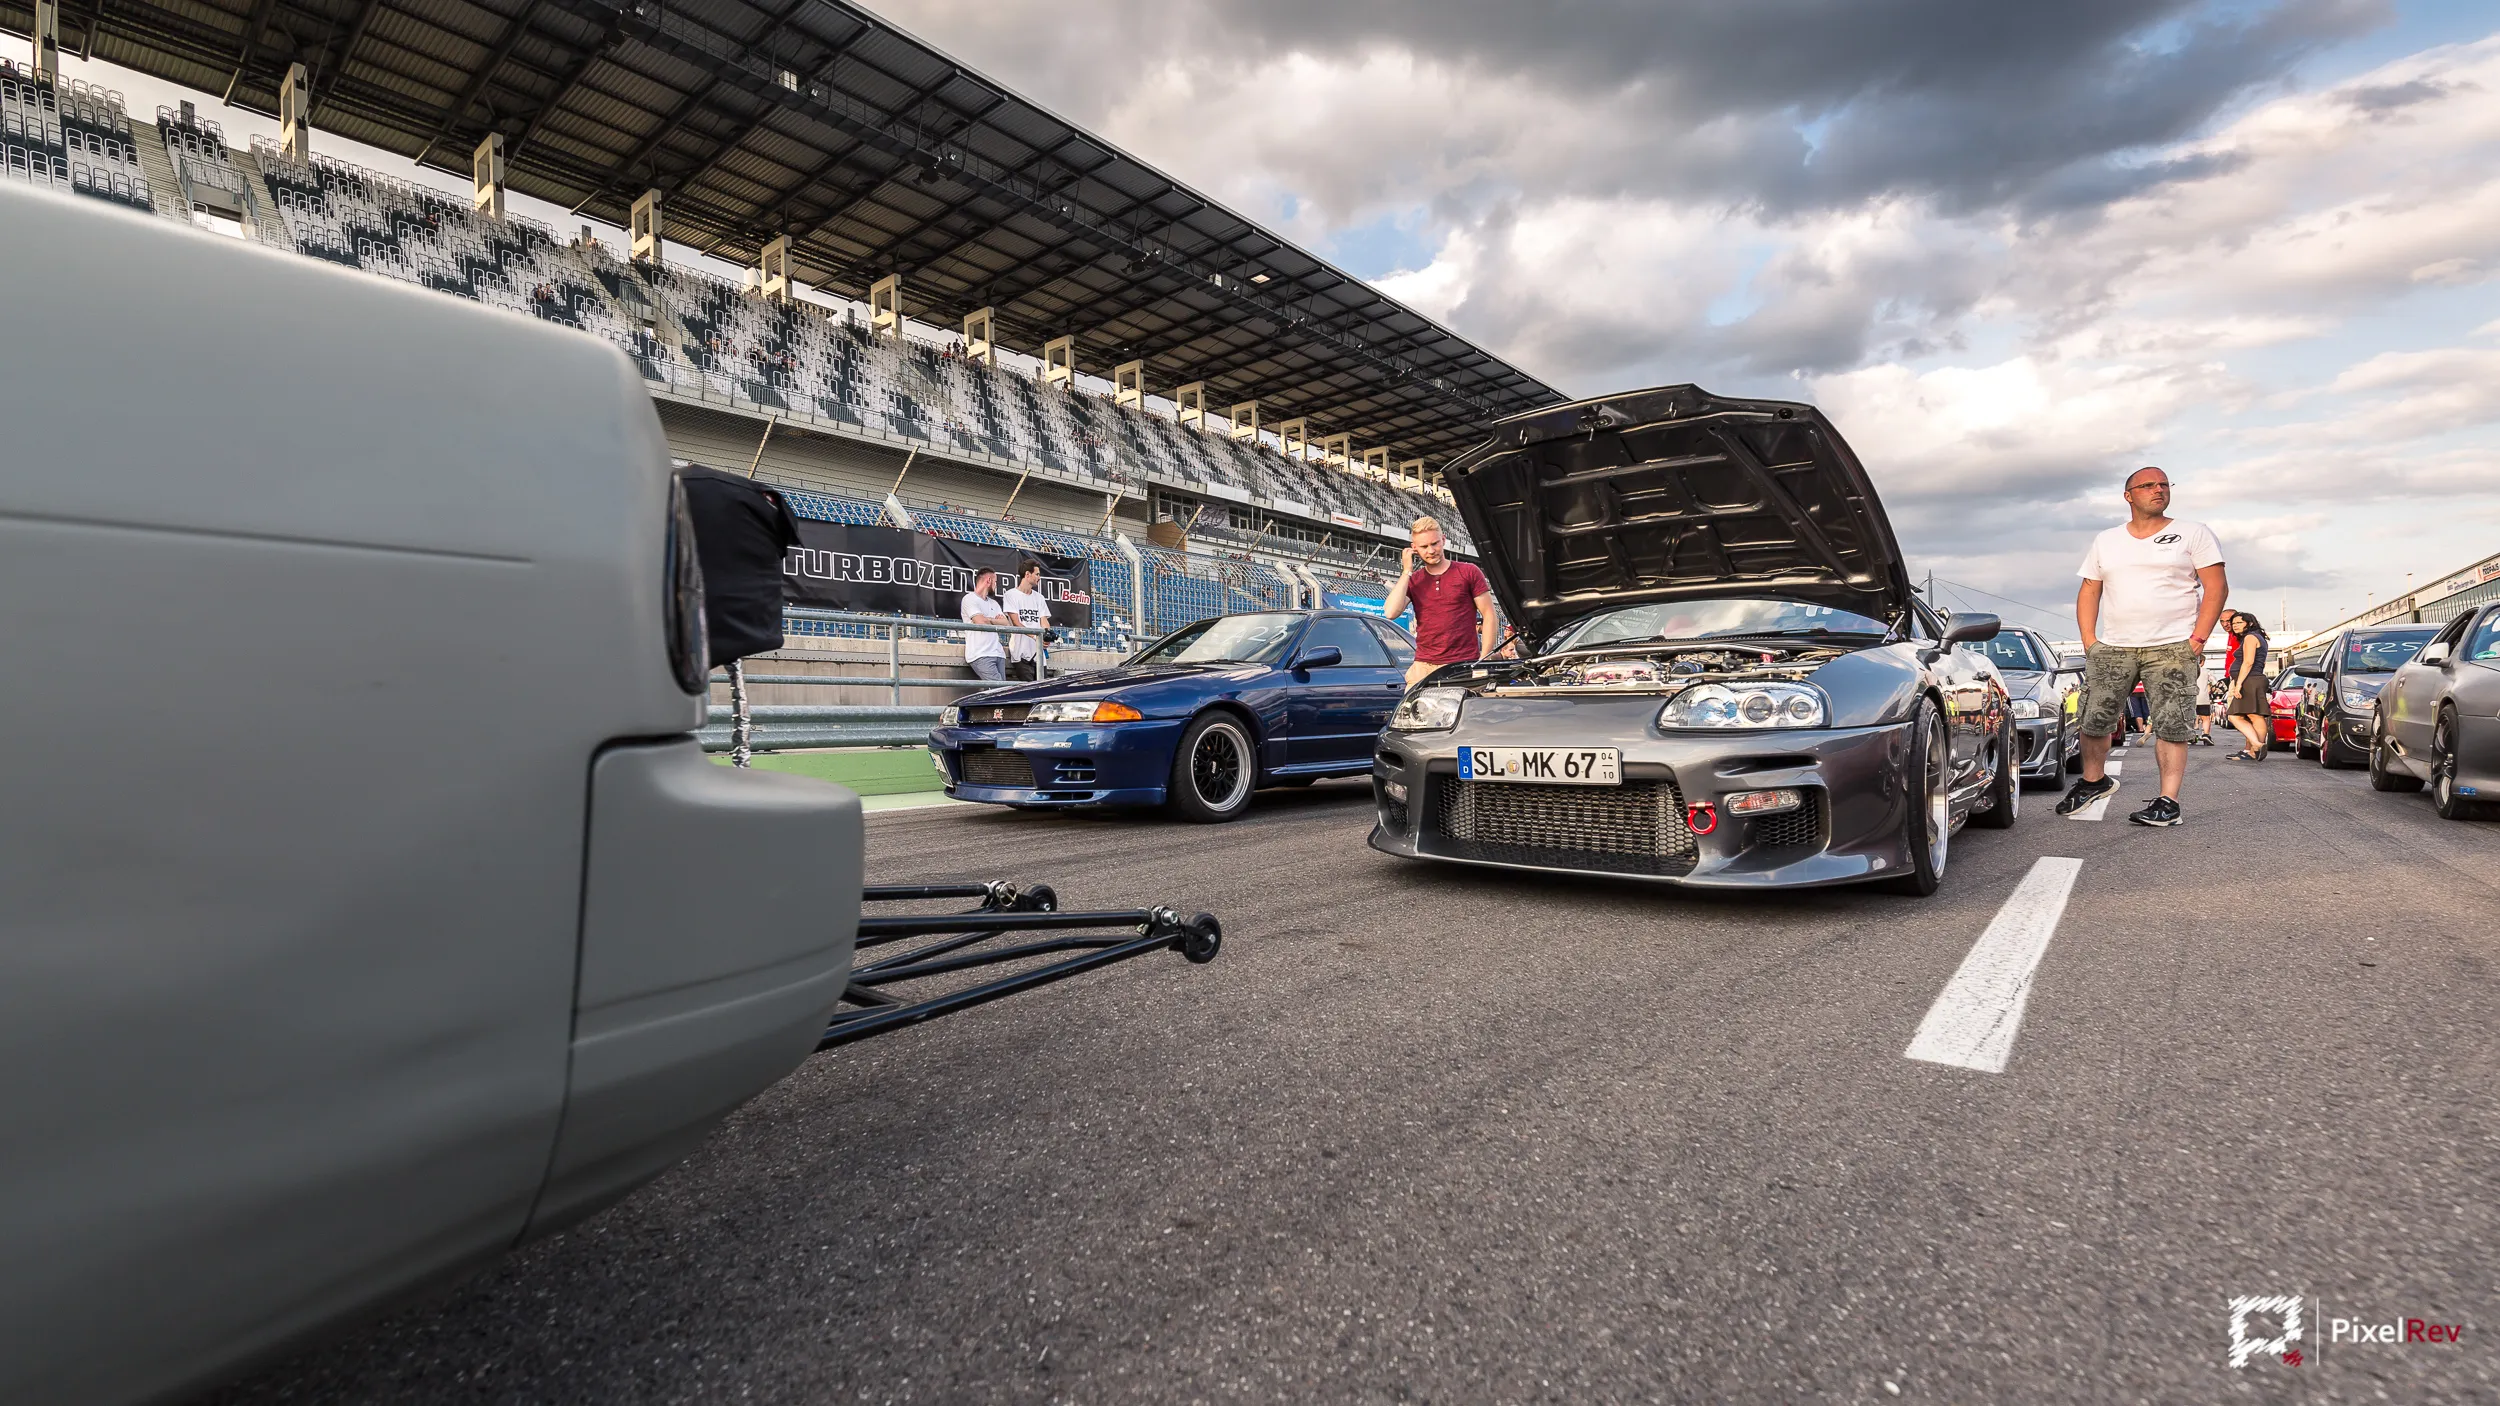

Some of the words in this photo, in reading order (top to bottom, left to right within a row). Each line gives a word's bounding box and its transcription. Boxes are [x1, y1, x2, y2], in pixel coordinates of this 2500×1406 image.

[782, 545, 1072, 602] TURBOZENRM
[1061, 590, 1091, 606] Berlin
[1601, 752, 1613, 761] 04
[1473, 751, 1505, 776] SL
[1522, 751, 1557, 778] MK
[1564, 752, 1597, 779] 67
[1603, 771, 1614, 780] 10
